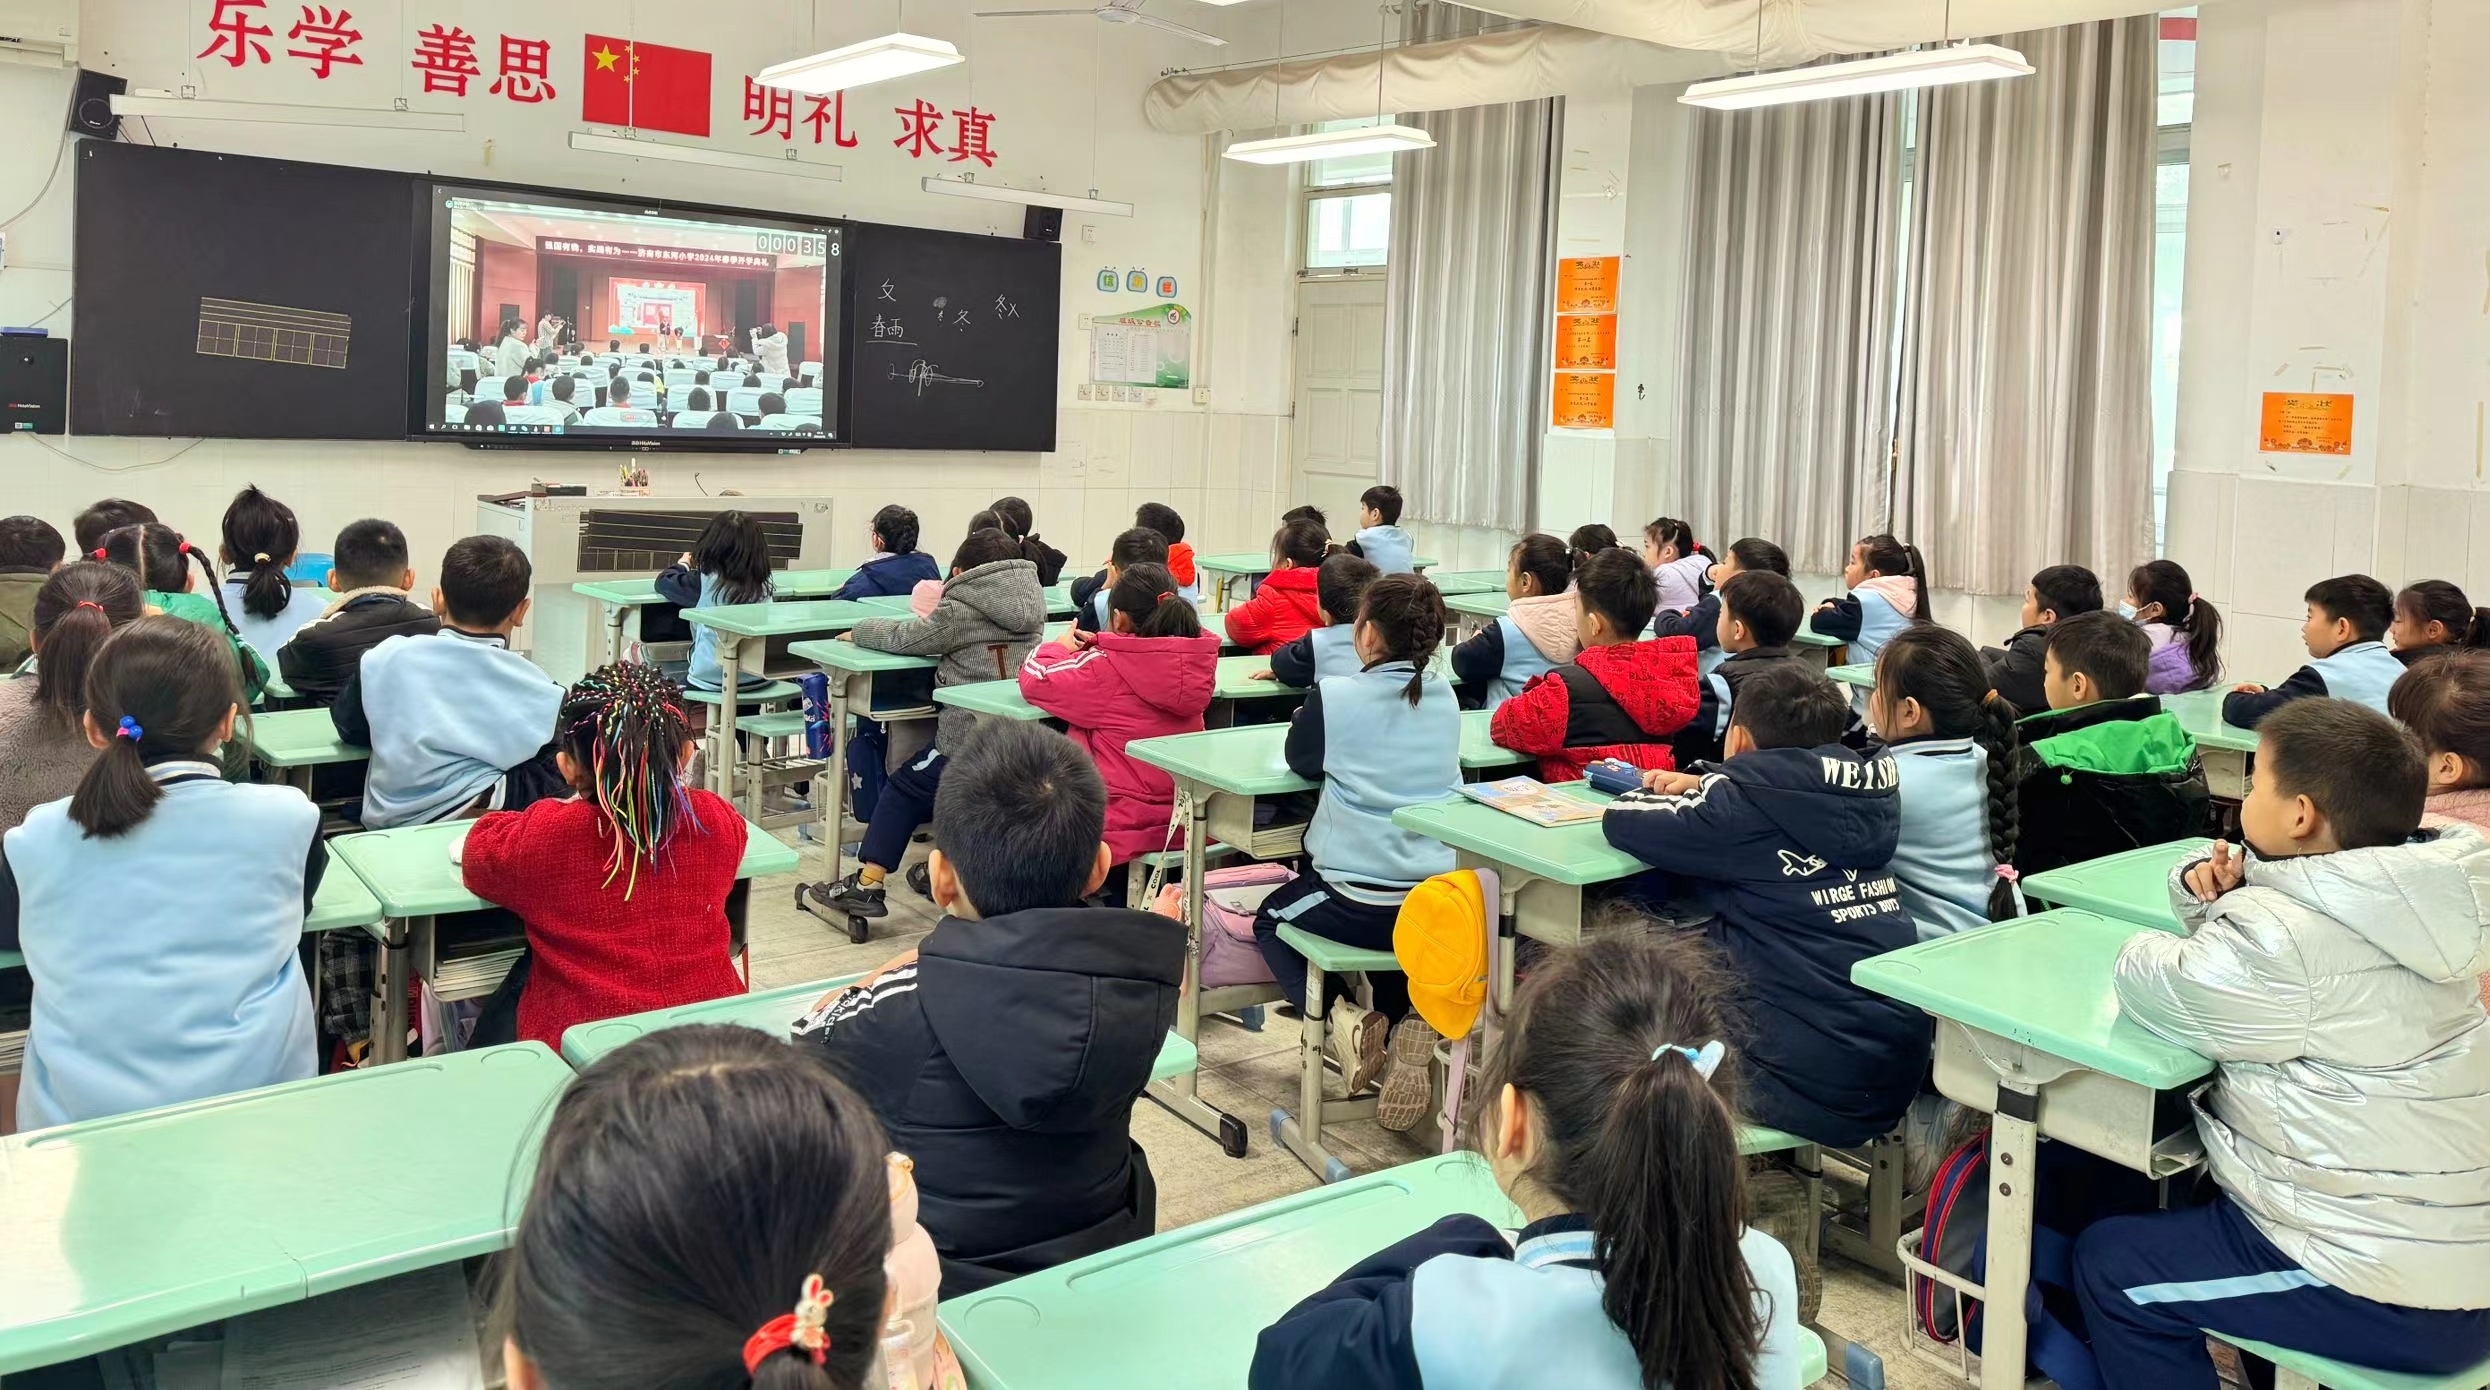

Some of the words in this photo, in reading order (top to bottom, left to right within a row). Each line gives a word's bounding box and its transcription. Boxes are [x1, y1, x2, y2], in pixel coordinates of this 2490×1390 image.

[197, 0, 363, 79] 乐学
[411, 24, 557, 103] 善思
[743, 75, 858, 148] 明礼
[893, 98, 998, 167] 求真
[870, 313, 904, 338] 春雨
[1810, 884, 1856, 907] WIRGE
[1830, 903, 1878, 924] SPORTS
[1875, 897, 1900, 913] BOYS
